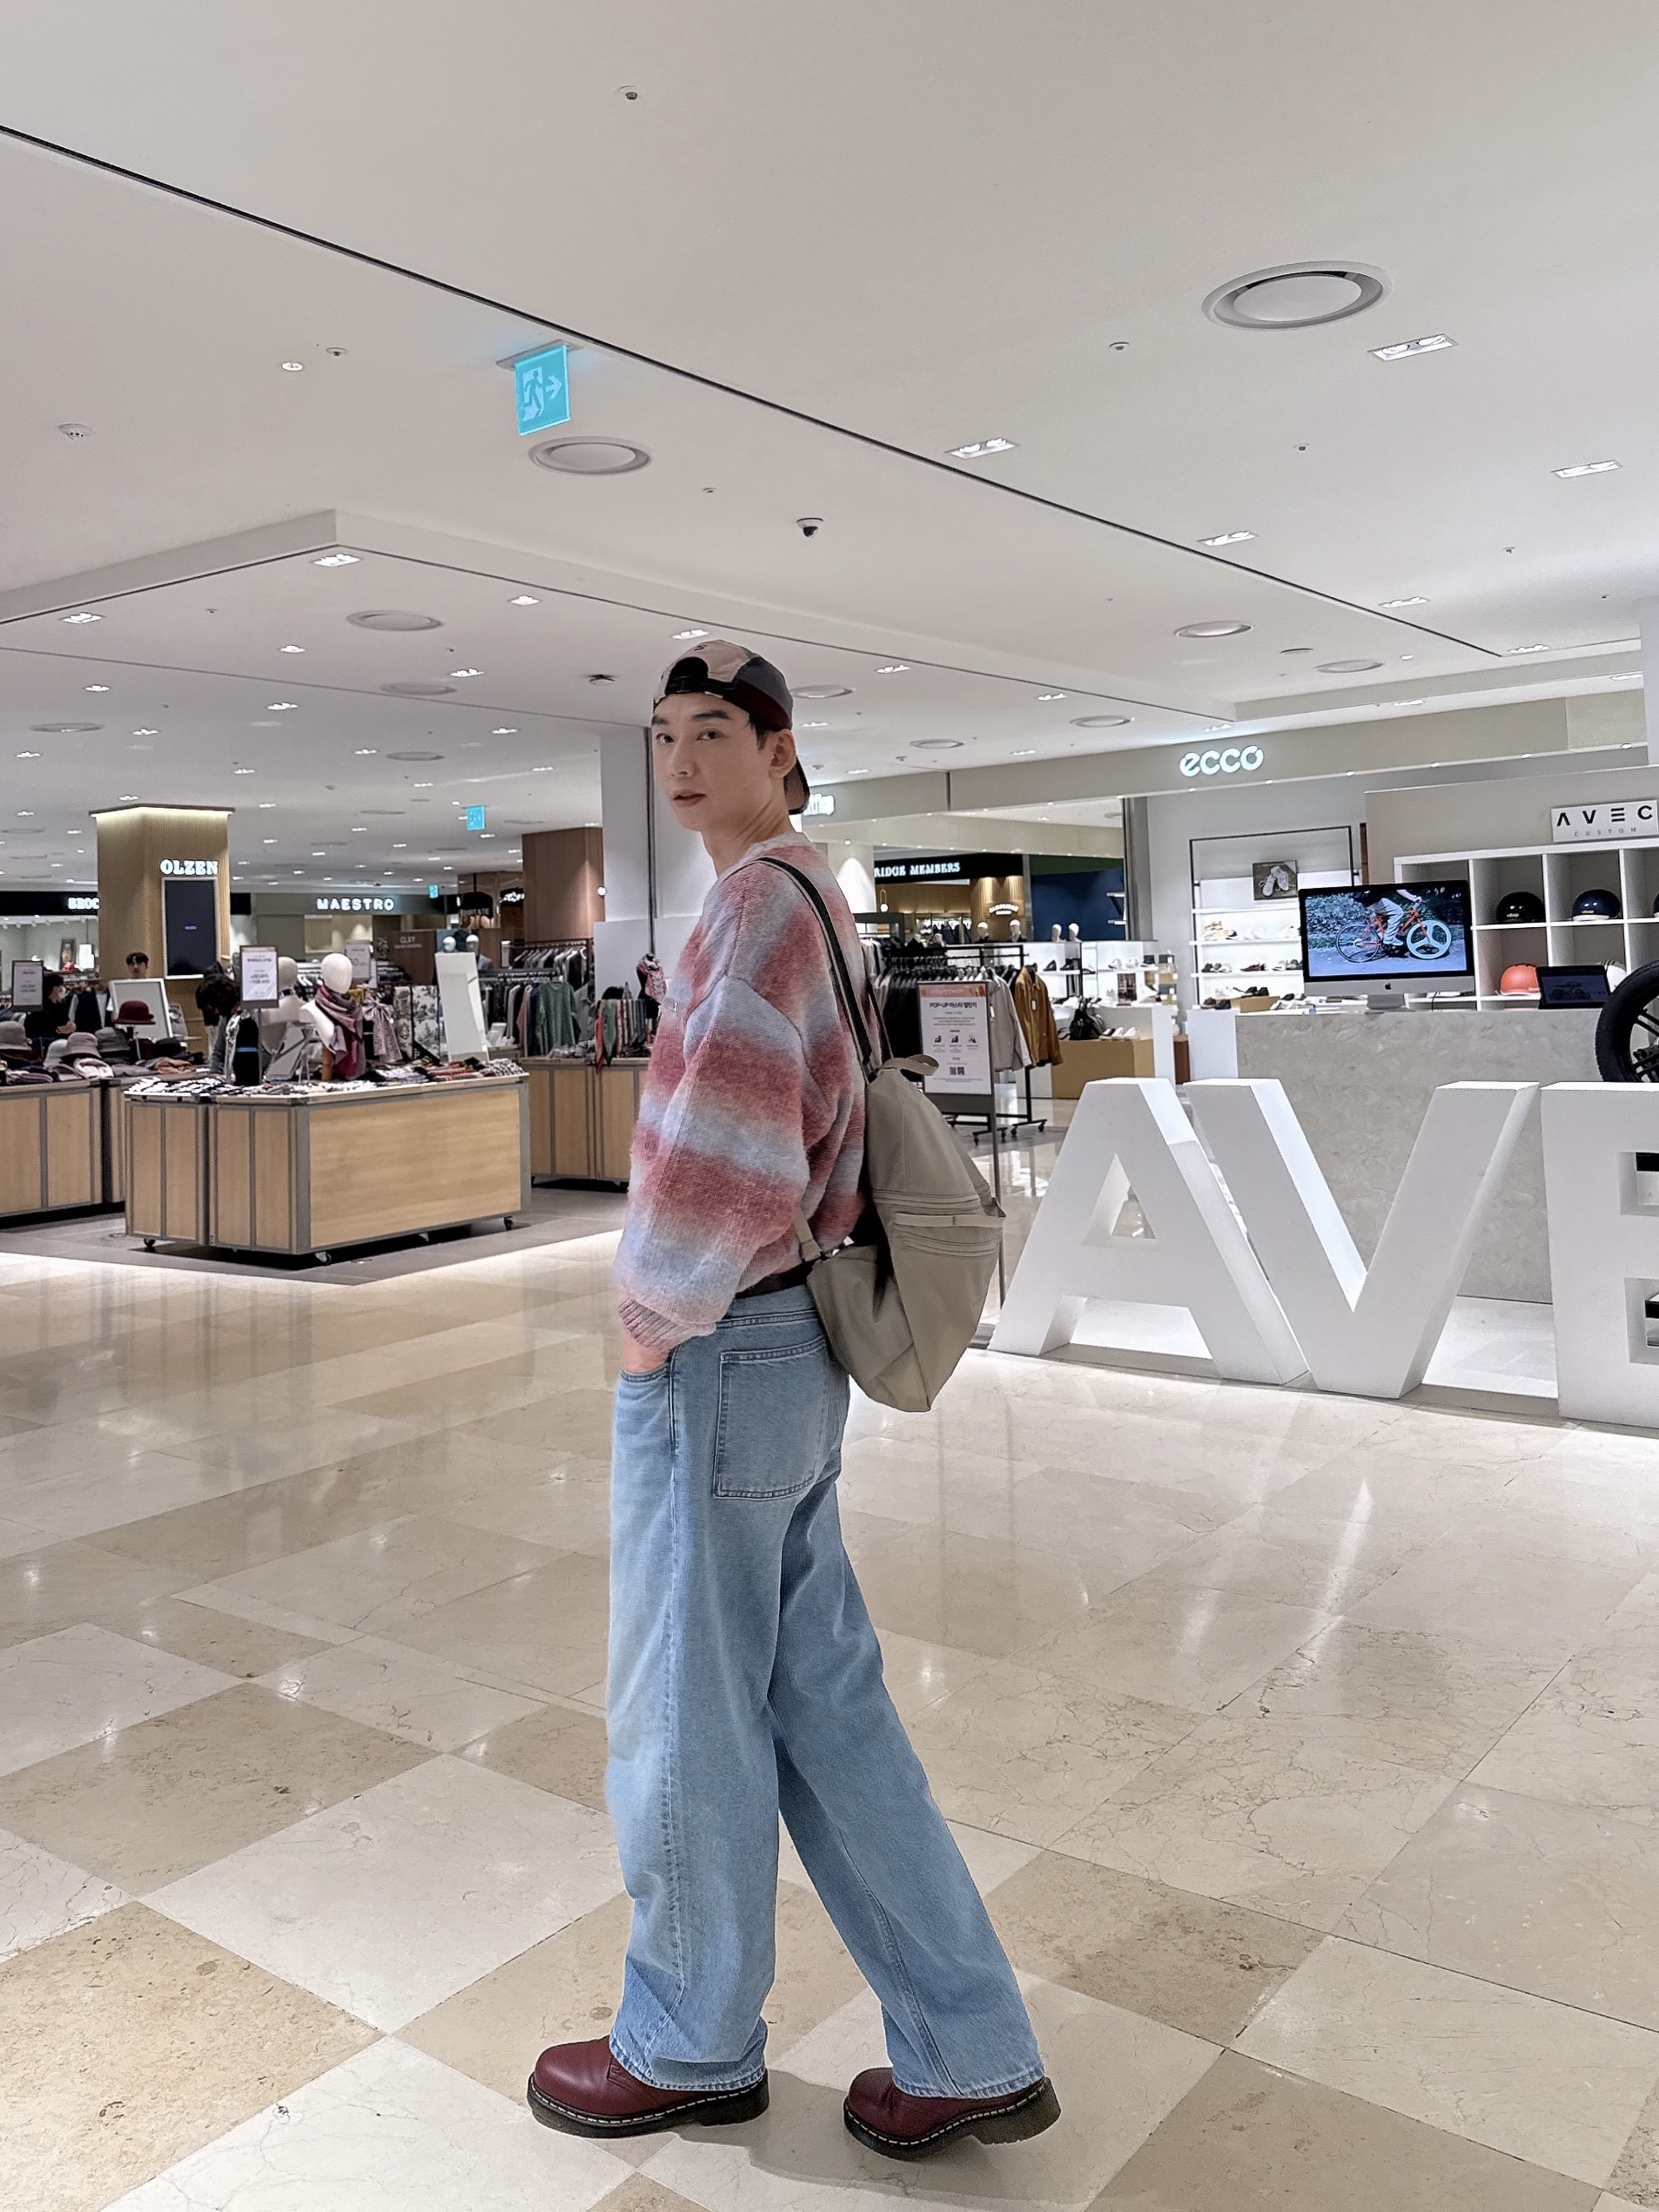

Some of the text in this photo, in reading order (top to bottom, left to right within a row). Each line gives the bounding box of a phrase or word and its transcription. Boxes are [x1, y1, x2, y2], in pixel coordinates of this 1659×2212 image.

[1179, 745, 1265, 777] ecco
[1574, 827, 1636, 837] CUSTOM
[159, 859, 218, 876] OLZEN
[910, 862, 960, 876] MEMBERS
[316, 898, 395, 911] MAESTRO
